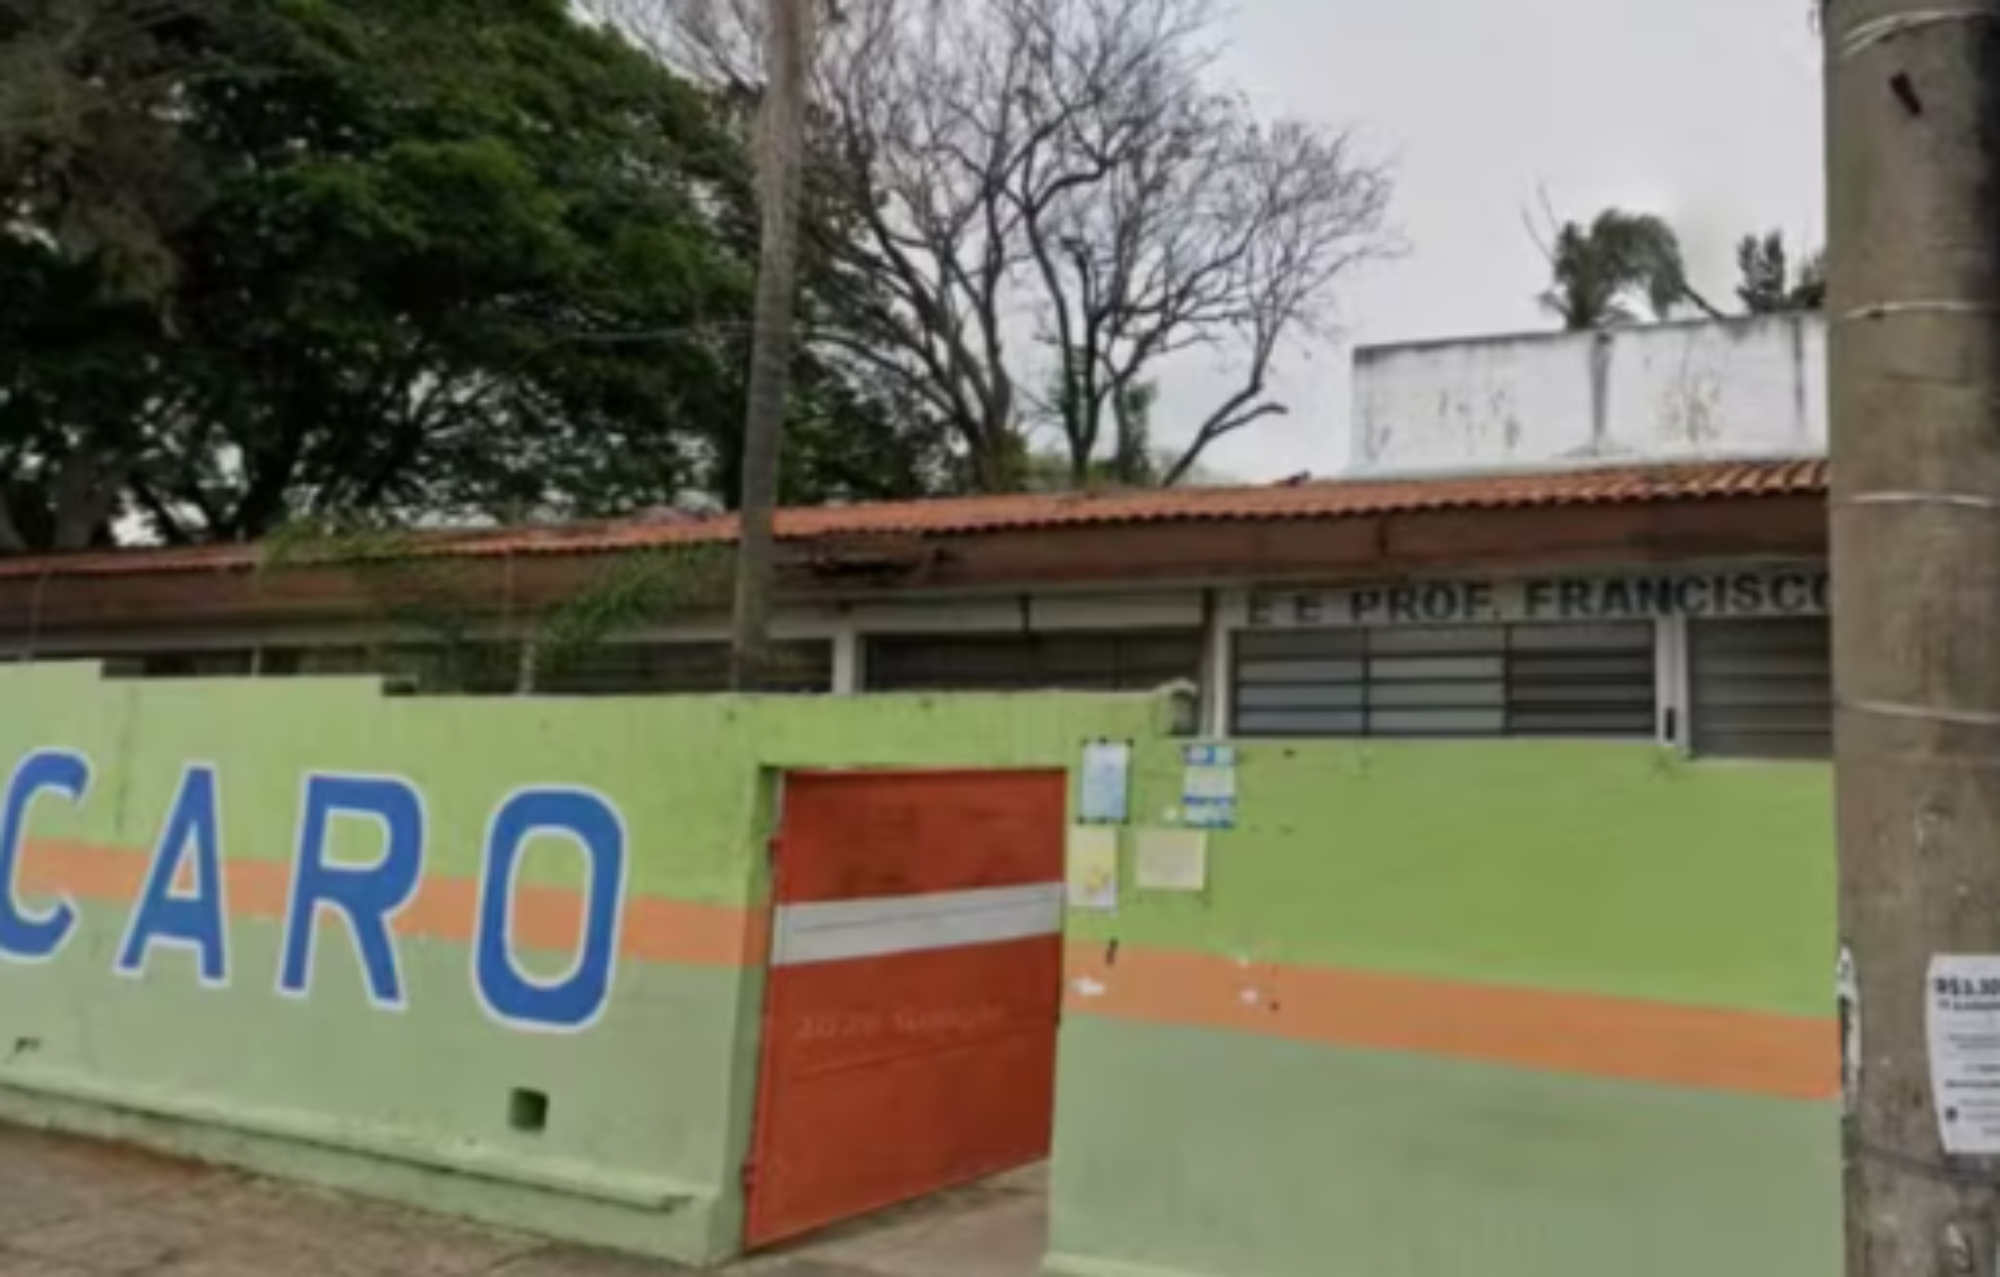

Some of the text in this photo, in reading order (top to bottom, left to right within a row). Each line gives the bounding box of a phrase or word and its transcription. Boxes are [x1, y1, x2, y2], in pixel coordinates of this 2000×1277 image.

[1249, 588, 1275, 624] E
[1295, 590, 1322, 623] E
[1351, 580, 1502, 620] PROF.
[0, 747, 628, 1034] CARO
